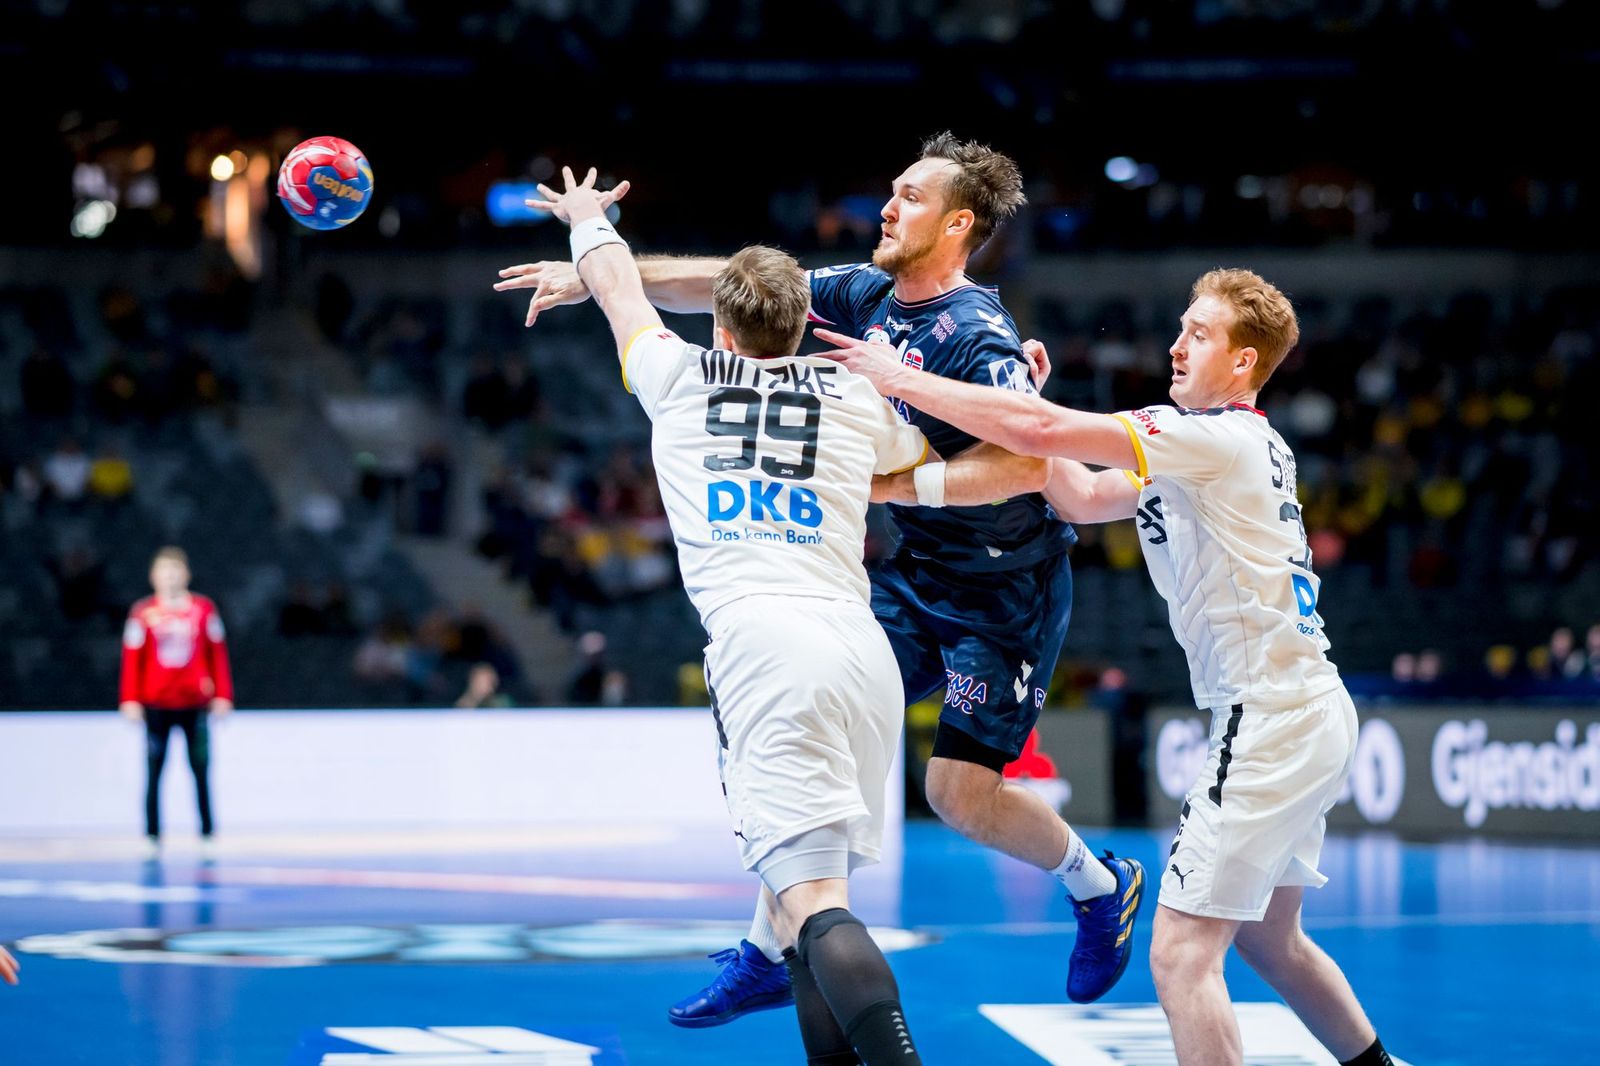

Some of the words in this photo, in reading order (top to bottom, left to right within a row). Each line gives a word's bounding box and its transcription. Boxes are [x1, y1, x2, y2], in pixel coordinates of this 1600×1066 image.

[314, 172, 365, 203] molten
[703, 386, 821, 480] 99
[707, 480, 823, 528] DKB
[712, 529, 740, 541] Das
[745, 527, 782, 542] kann
[786, 529, 823, 544] Bank
[1432, 719, 1600, 828] Gjensid
